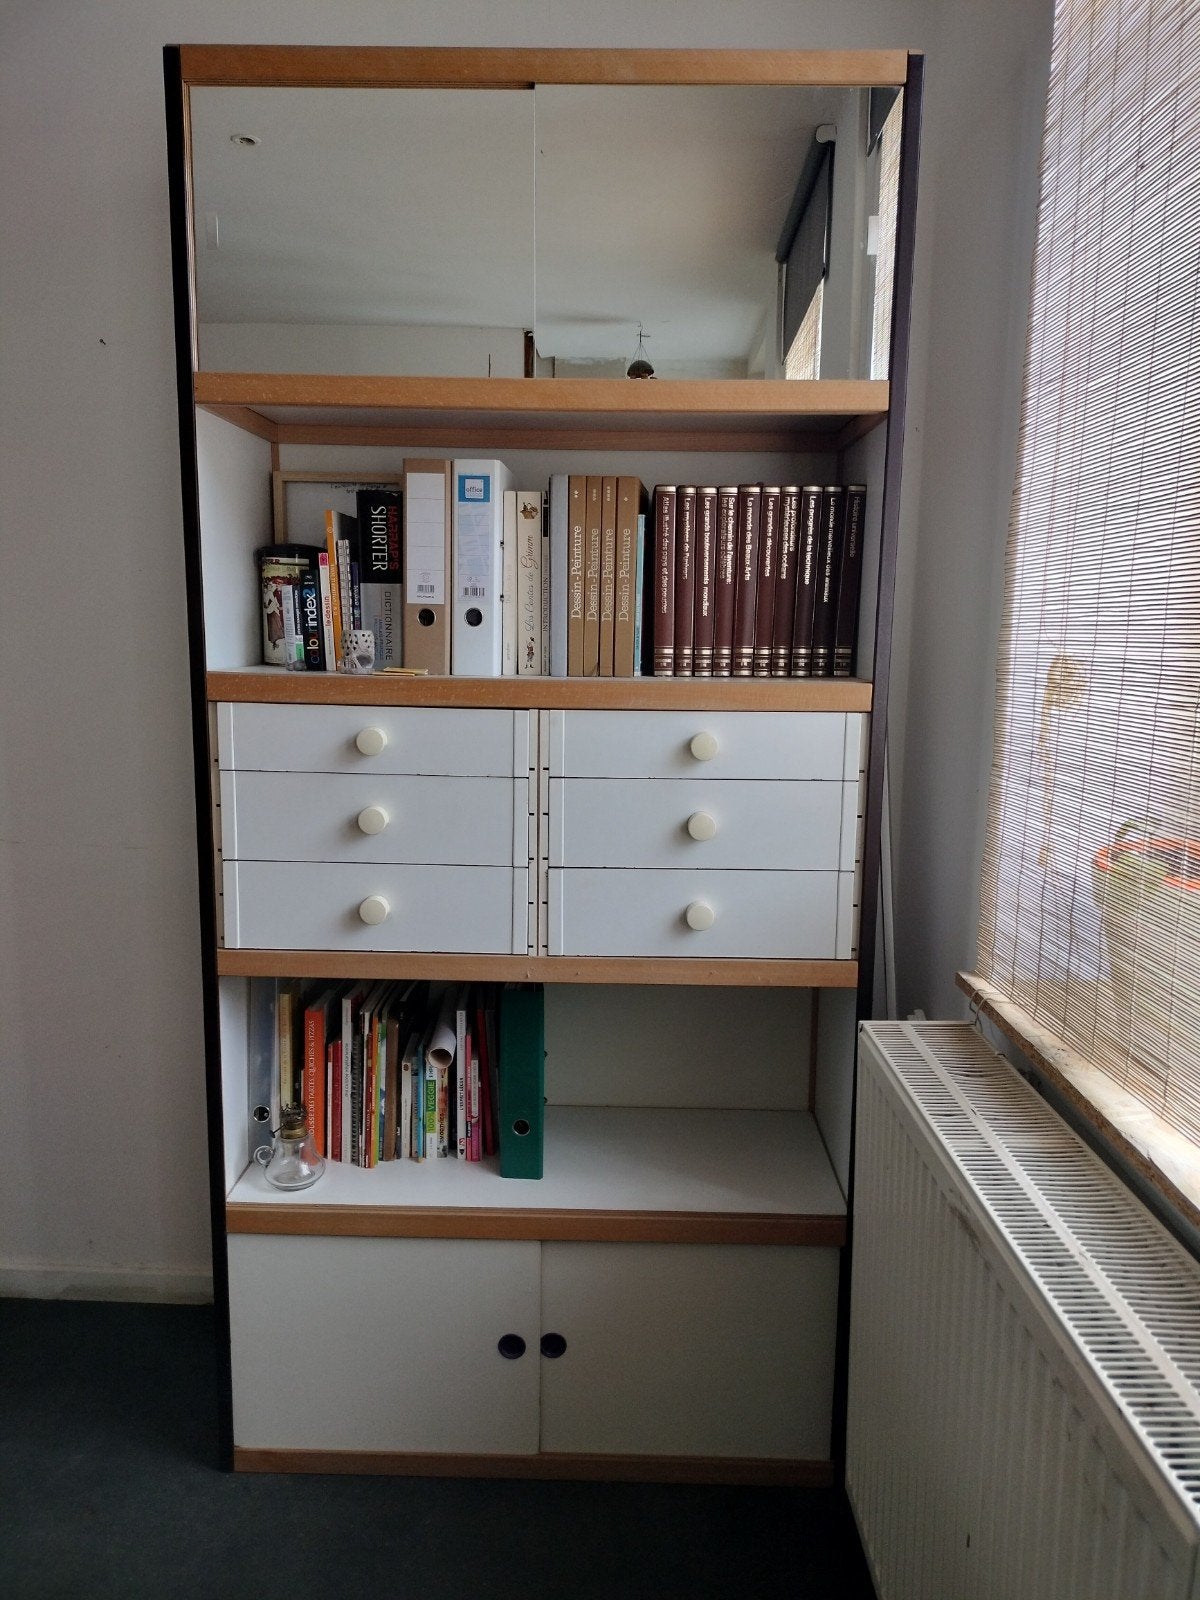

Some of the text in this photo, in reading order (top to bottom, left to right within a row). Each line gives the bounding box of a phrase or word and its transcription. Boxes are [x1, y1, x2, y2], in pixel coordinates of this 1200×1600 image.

[704, 497, 712, 509] Les
[852, 496, 860, 521] Histoire
[703, 510, 711, 532] grands
[727, 516, 735, 541] chemin
[745, 507, 753, 531] monde
[766, 510, 774, 536] grandes
[807, 508, 815, 535] progrès
[371, 505, 388, 571] SHORTER
[388, 505, 399, 570] HARRAP'S
[661, 538, 669, 550] des
[683, 543, 690, 552] de
[726, 542, 734, 551] de
[806, 544, 813, 552] la
[807, 535, 814, 544] de
[660, 551, 668, 566] pays
[703, 532, 711, 584] bouleversements
[744, 544, 752, 581] Beaux-Arts
[764, 537, 773, 577] découvertes
[780, 554, 788, 580] océans
[804, 551, 813, 585] technique
[520, 535, 538, 632] Les Contes de Grimm
[384, 591, 393, 660] DICTIONNAIRE
[308, 1048, 316, 1077] QUICHES
[427, 1081, 435, 1110] VEGGIE
